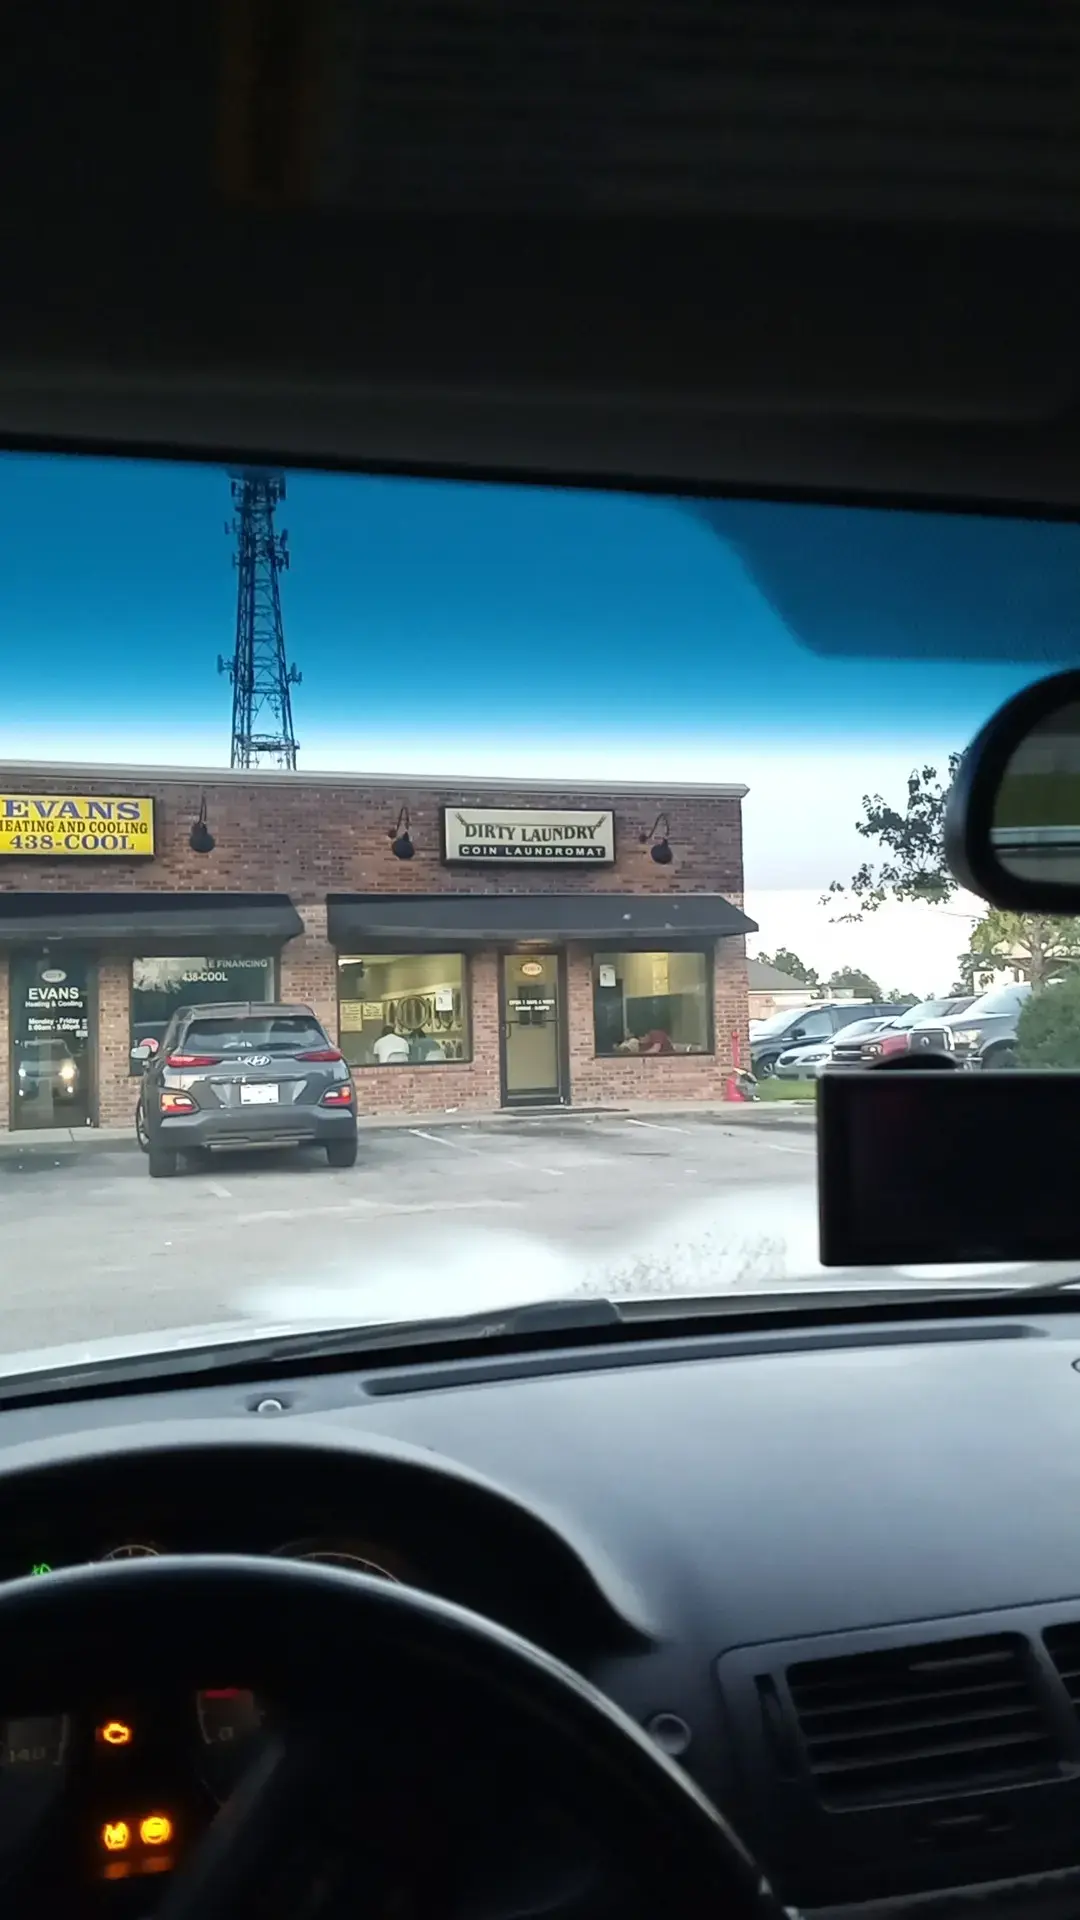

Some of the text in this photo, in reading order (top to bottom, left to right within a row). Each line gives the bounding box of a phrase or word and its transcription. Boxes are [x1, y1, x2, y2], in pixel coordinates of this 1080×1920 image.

[2, 800, 141, 820] EVANS
[57, 821, 86, 833] AND
[88, 822, 148, 834] COOLING
[465, 823, 597, 842] DIRTY LAUNDRY
[9, 834, 135, 850] 438-COOL
[461, 846, 603, 856] COIN LAUNDROMAT
[216, 959, 268, 969] FINANCING
[182, 971, 229, 982] 438-COOL
[28, 987, 80, 1000] EVANS
[59, 1017, 79, 1026] Friday
